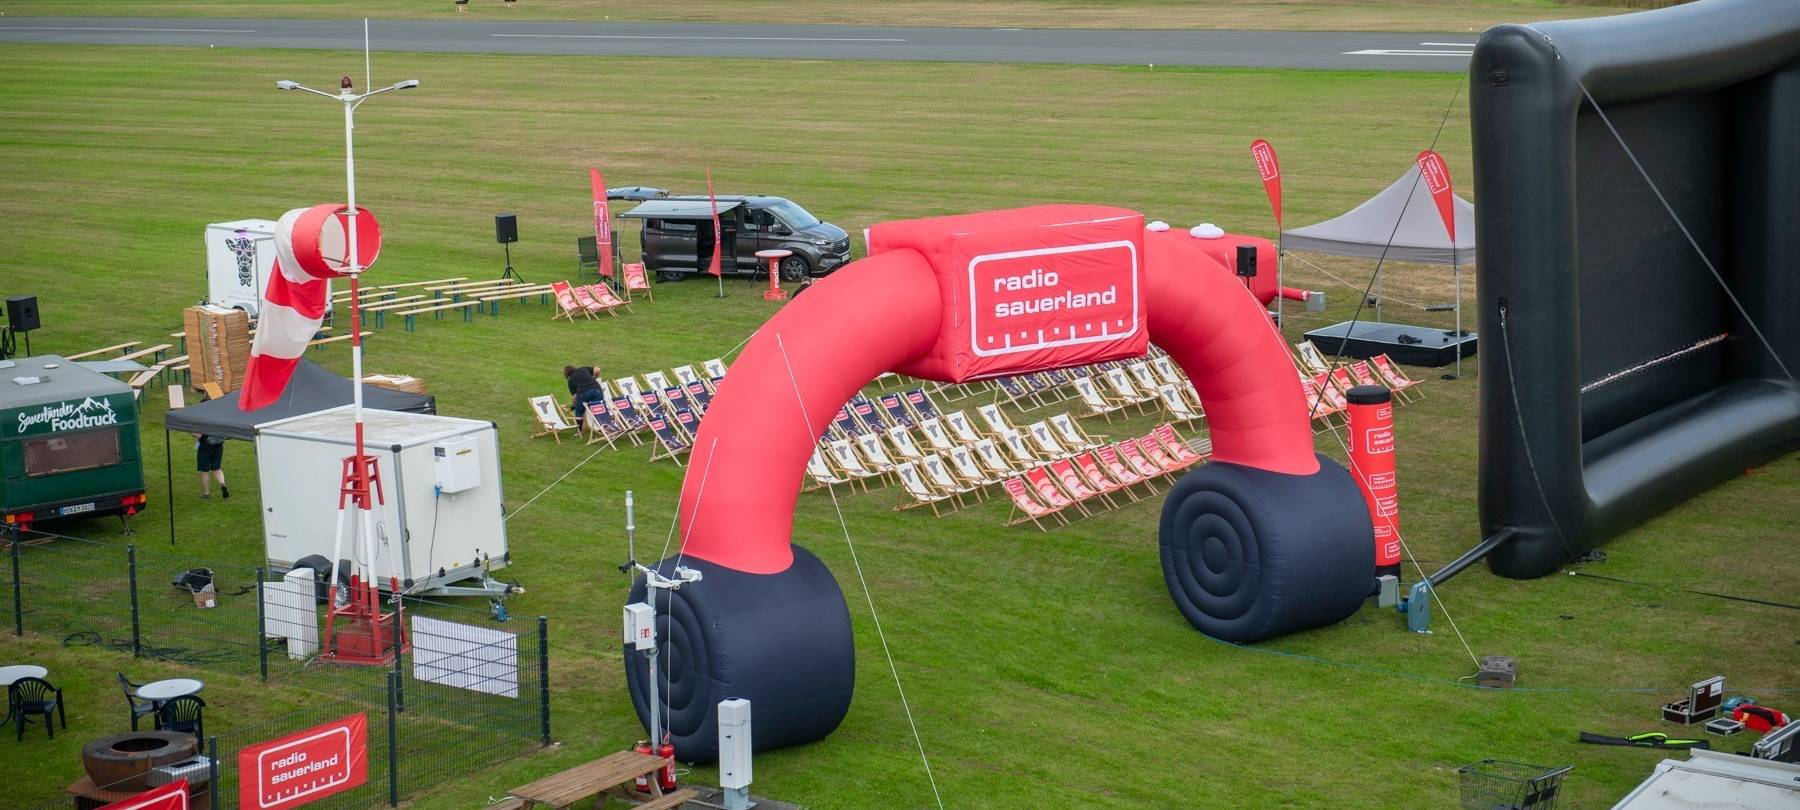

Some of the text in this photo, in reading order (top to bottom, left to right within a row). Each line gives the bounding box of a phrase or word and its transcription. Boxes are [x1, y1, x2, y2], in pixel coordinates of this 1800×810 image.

[772, 261, 780, 289] radio
[994, 268, 1059, 293] radio
[994, 285, 1116, 318] sauerland
[51, 410, 118, 432] Foodtruck
[271, 752, 307, 771] radio
[271, 753, 338, 785] sauerland
